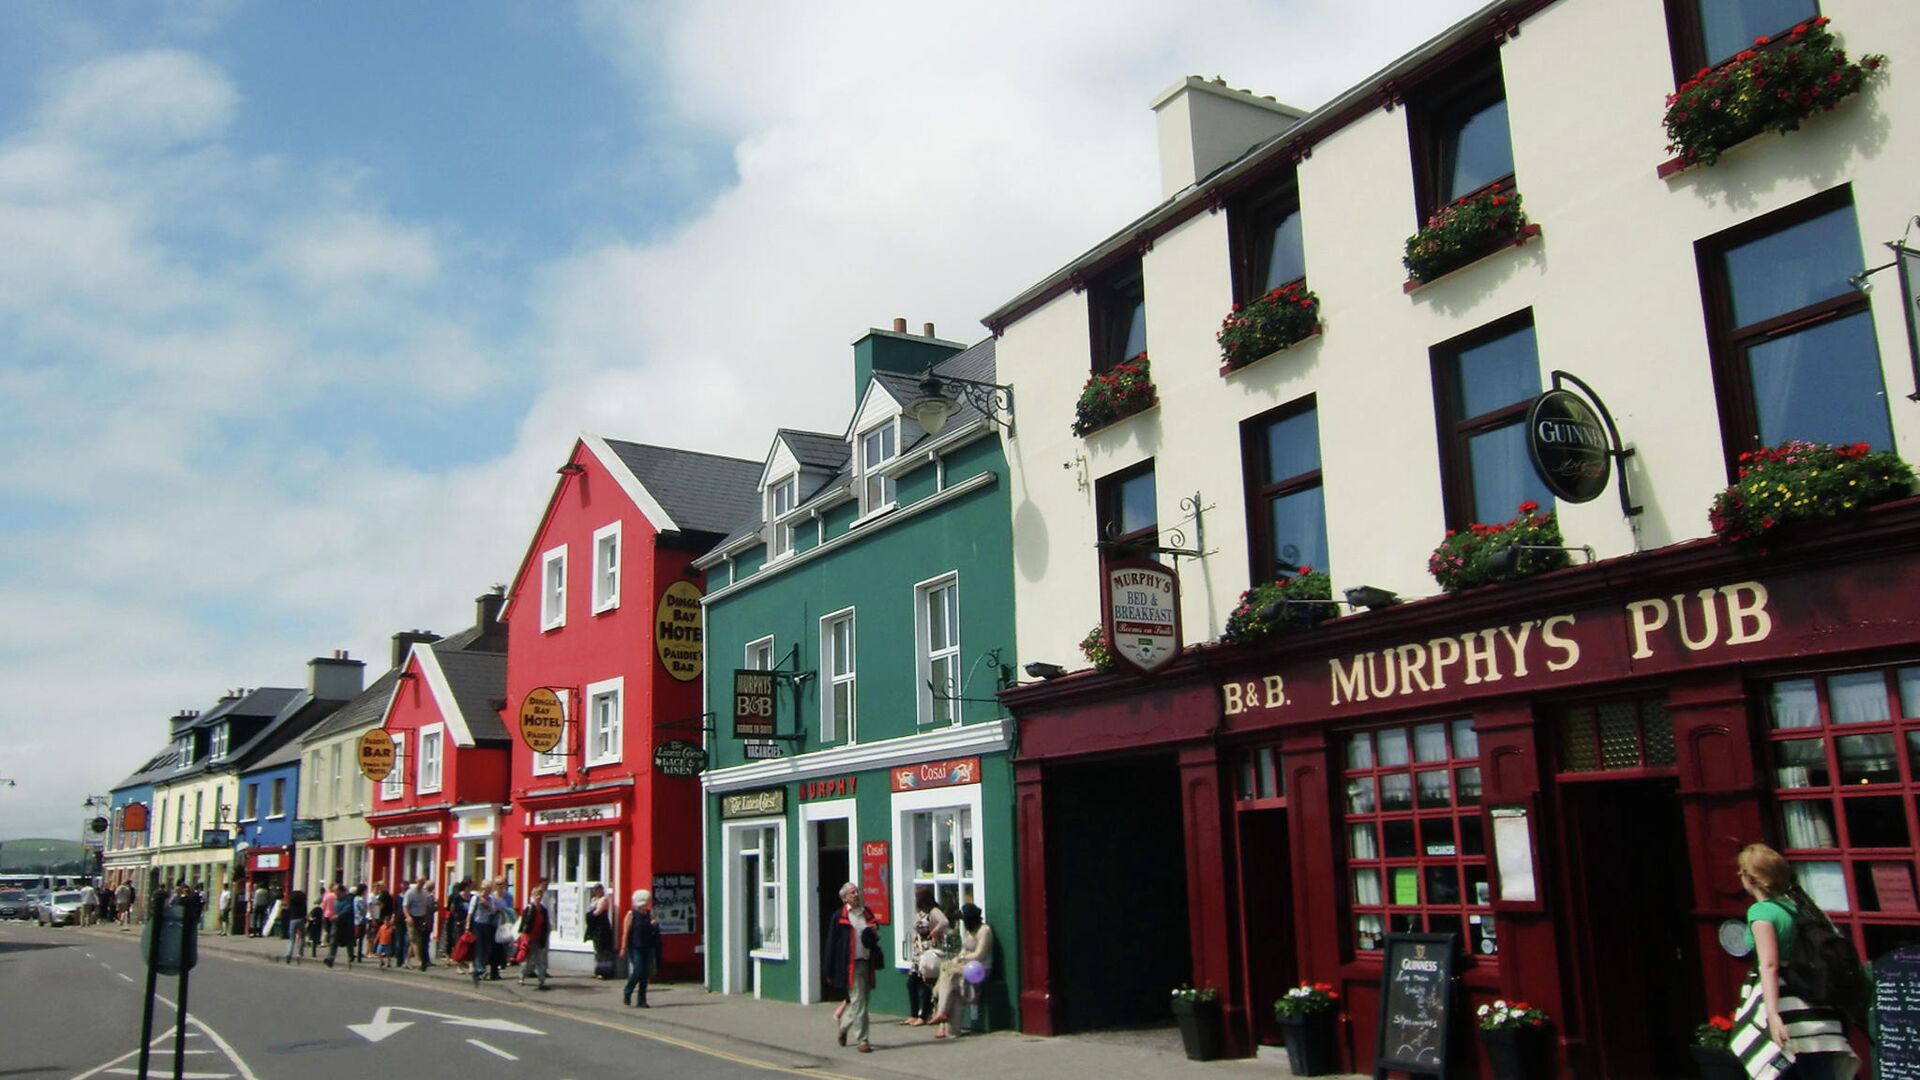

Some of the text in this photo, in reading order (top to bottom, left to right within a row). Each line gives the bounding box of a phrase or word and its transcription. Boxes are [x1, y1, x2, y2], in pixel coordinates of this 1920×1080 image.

[1114, 573, 1171, 593] MURPHY'S
[1128, 591, 1158, 606] BED &
[673, 609, 697, 622] BAY
[1115, 605, 1172, 622] BREAKFAST
[659, 621, 702, 641] HOTE
[1329, 581, 1772, 706] MURPHY'S PUB
[672, 661, 694, 672] BAR
[737, 696, 772, 717] B&B
[524, 714, 561, 727] HOTEL
[363, 746, 391, 758] BAR
[799, 776, 857, 801] MURPHY
[1401, 958, 1439, 972] GUINNESS
